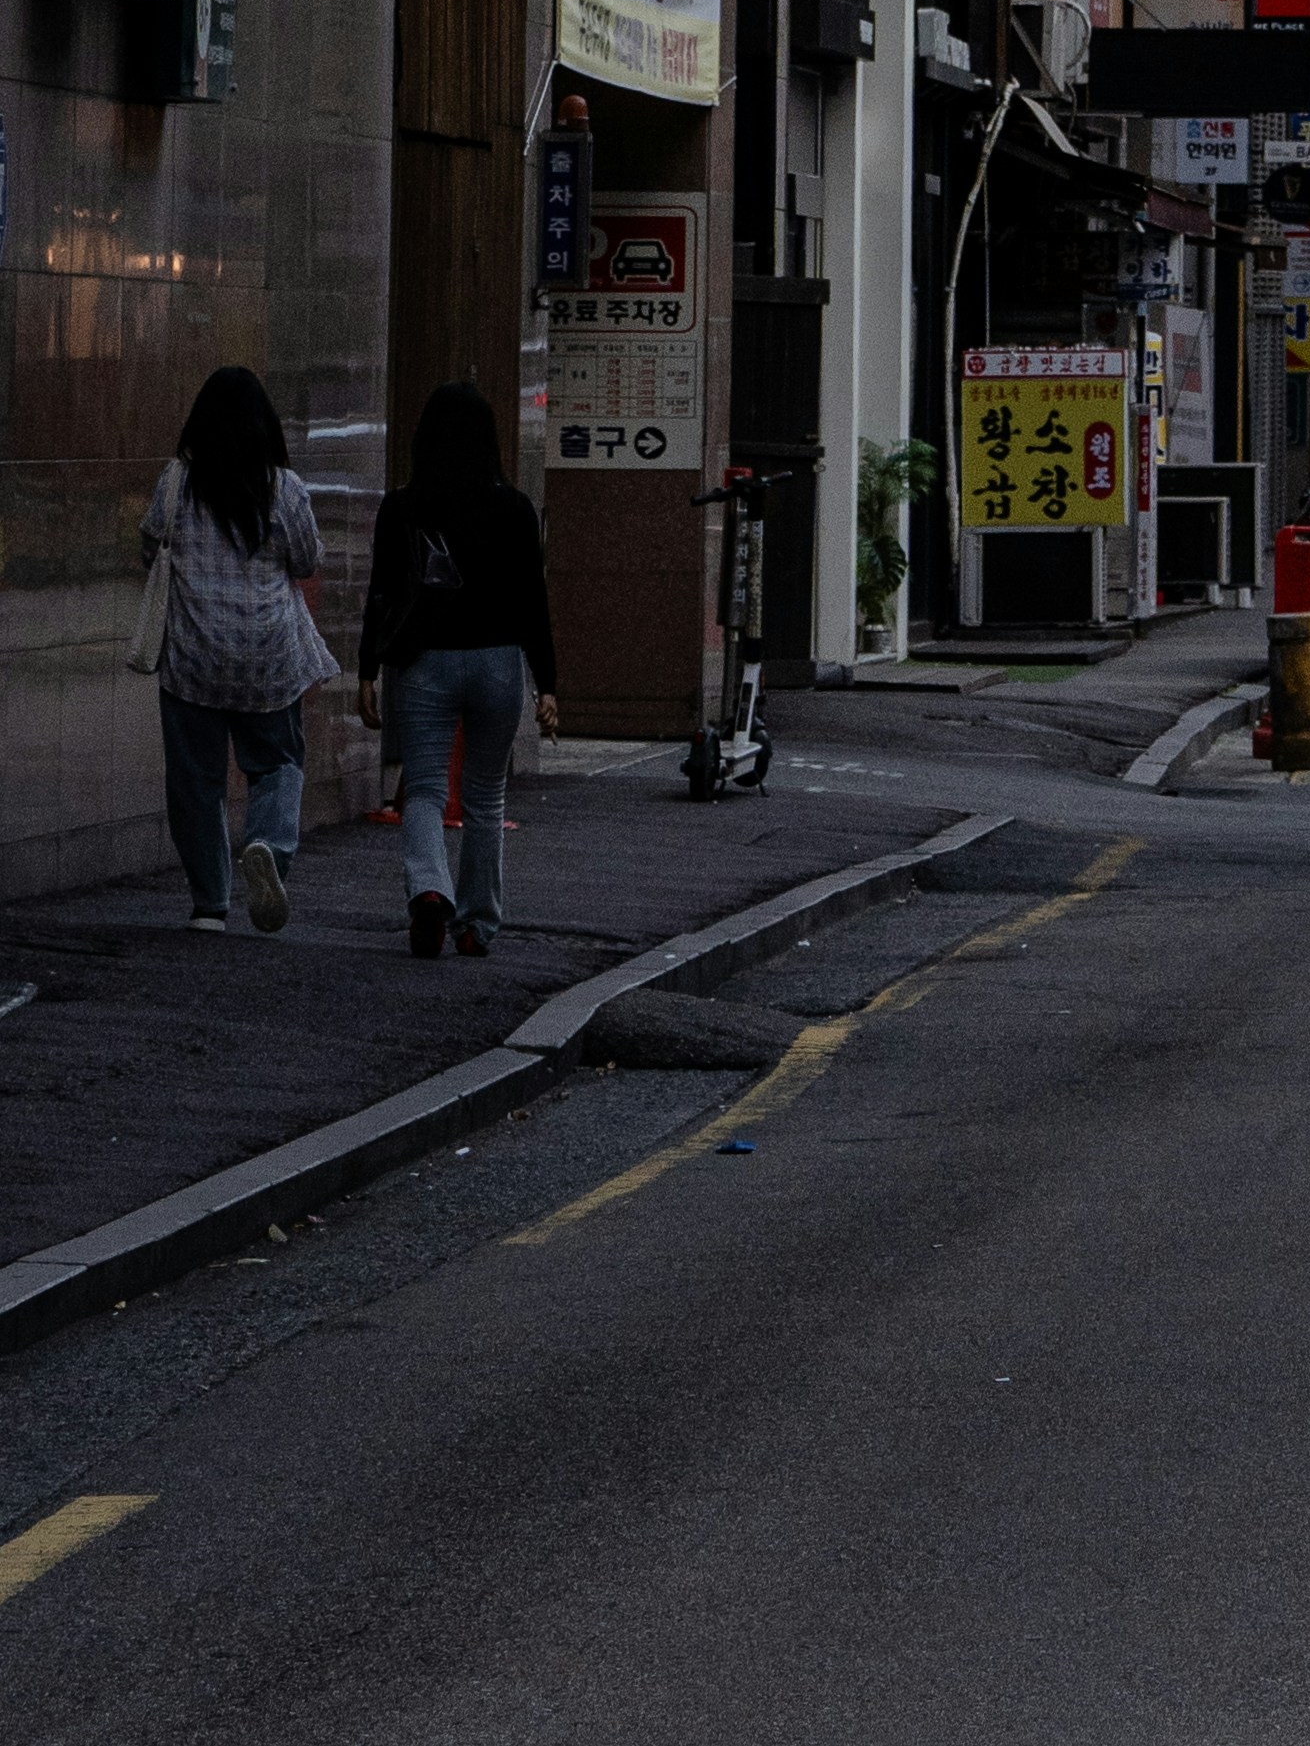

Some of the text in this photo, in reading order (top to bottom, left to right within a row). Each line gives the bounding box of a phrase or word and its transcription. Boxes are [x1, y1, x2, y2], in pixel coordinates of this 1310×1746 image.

[549, 298, 682, 328] 유료 주차장
[559, 425, 629, 460] 출구
[1086, 431, 1112, 491] 원조
[972, 464, 1077, 521] 곱창
